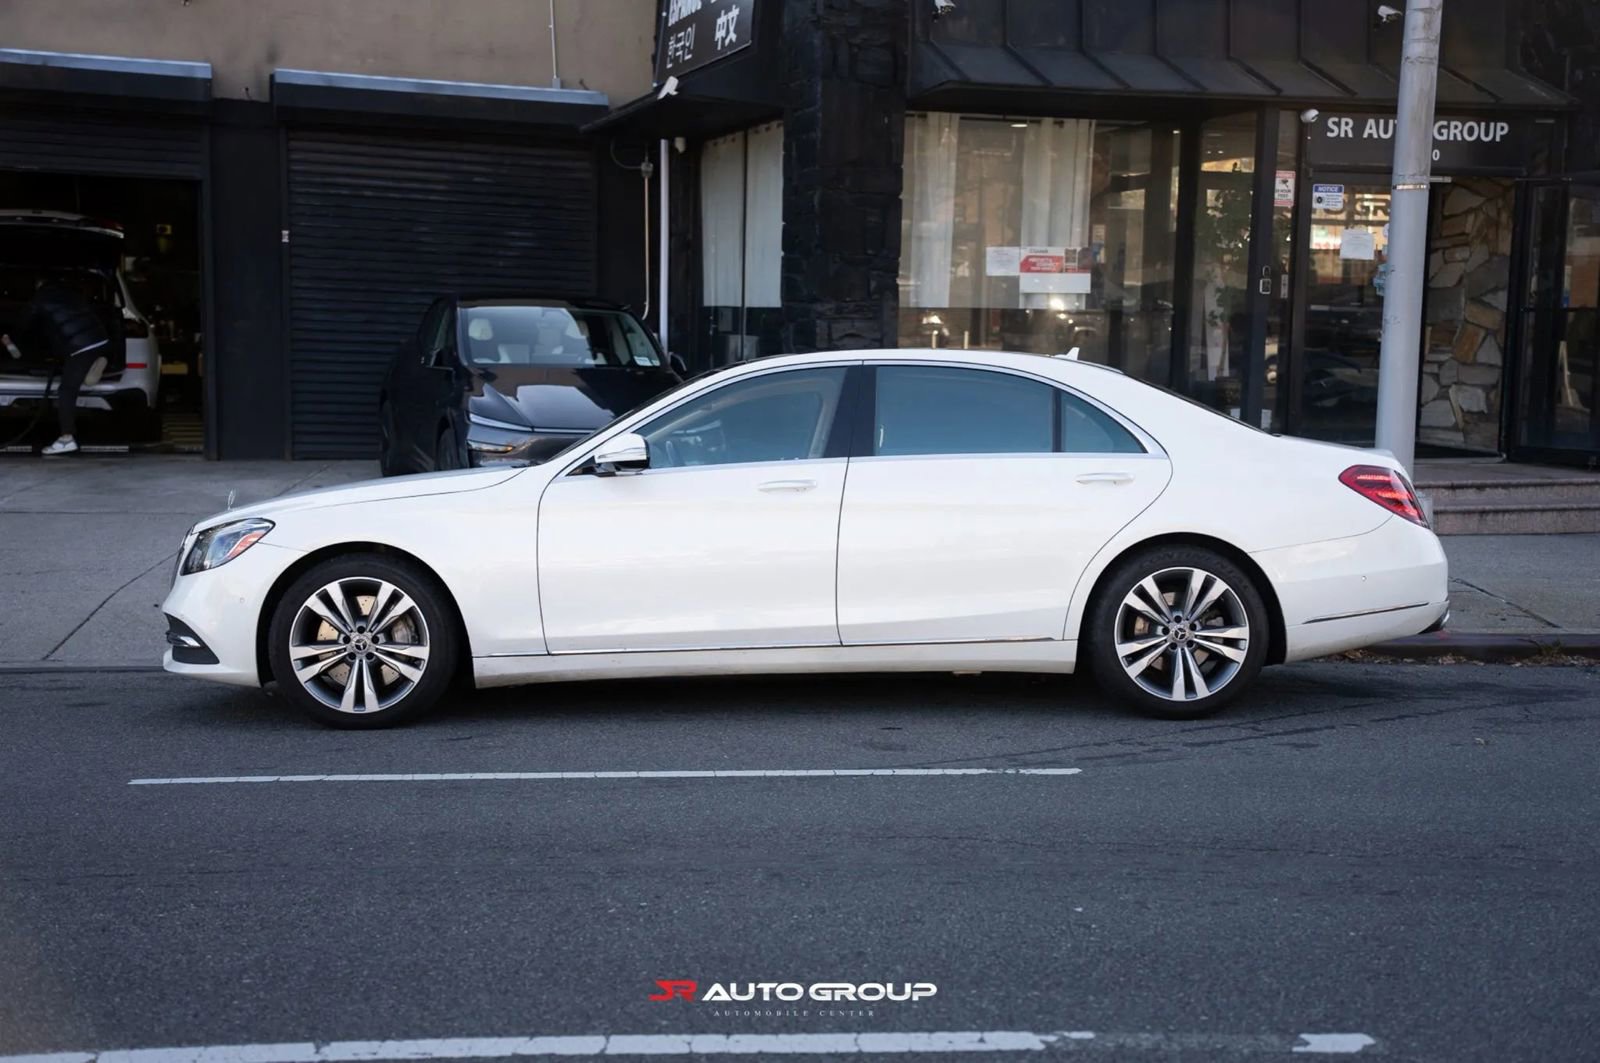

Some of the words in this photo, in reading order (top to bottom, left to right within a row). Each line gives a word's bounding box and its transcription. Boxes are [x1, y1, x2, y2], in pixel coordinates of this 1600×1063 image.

[666, 23, 696, 69] 한국인
[714, 4, 740, 51] 中文
[1326, 117, 1354, 138] SR
[1362, 118, 1398, 139] AU
[1433, 120, 1510, 142] GROUP
